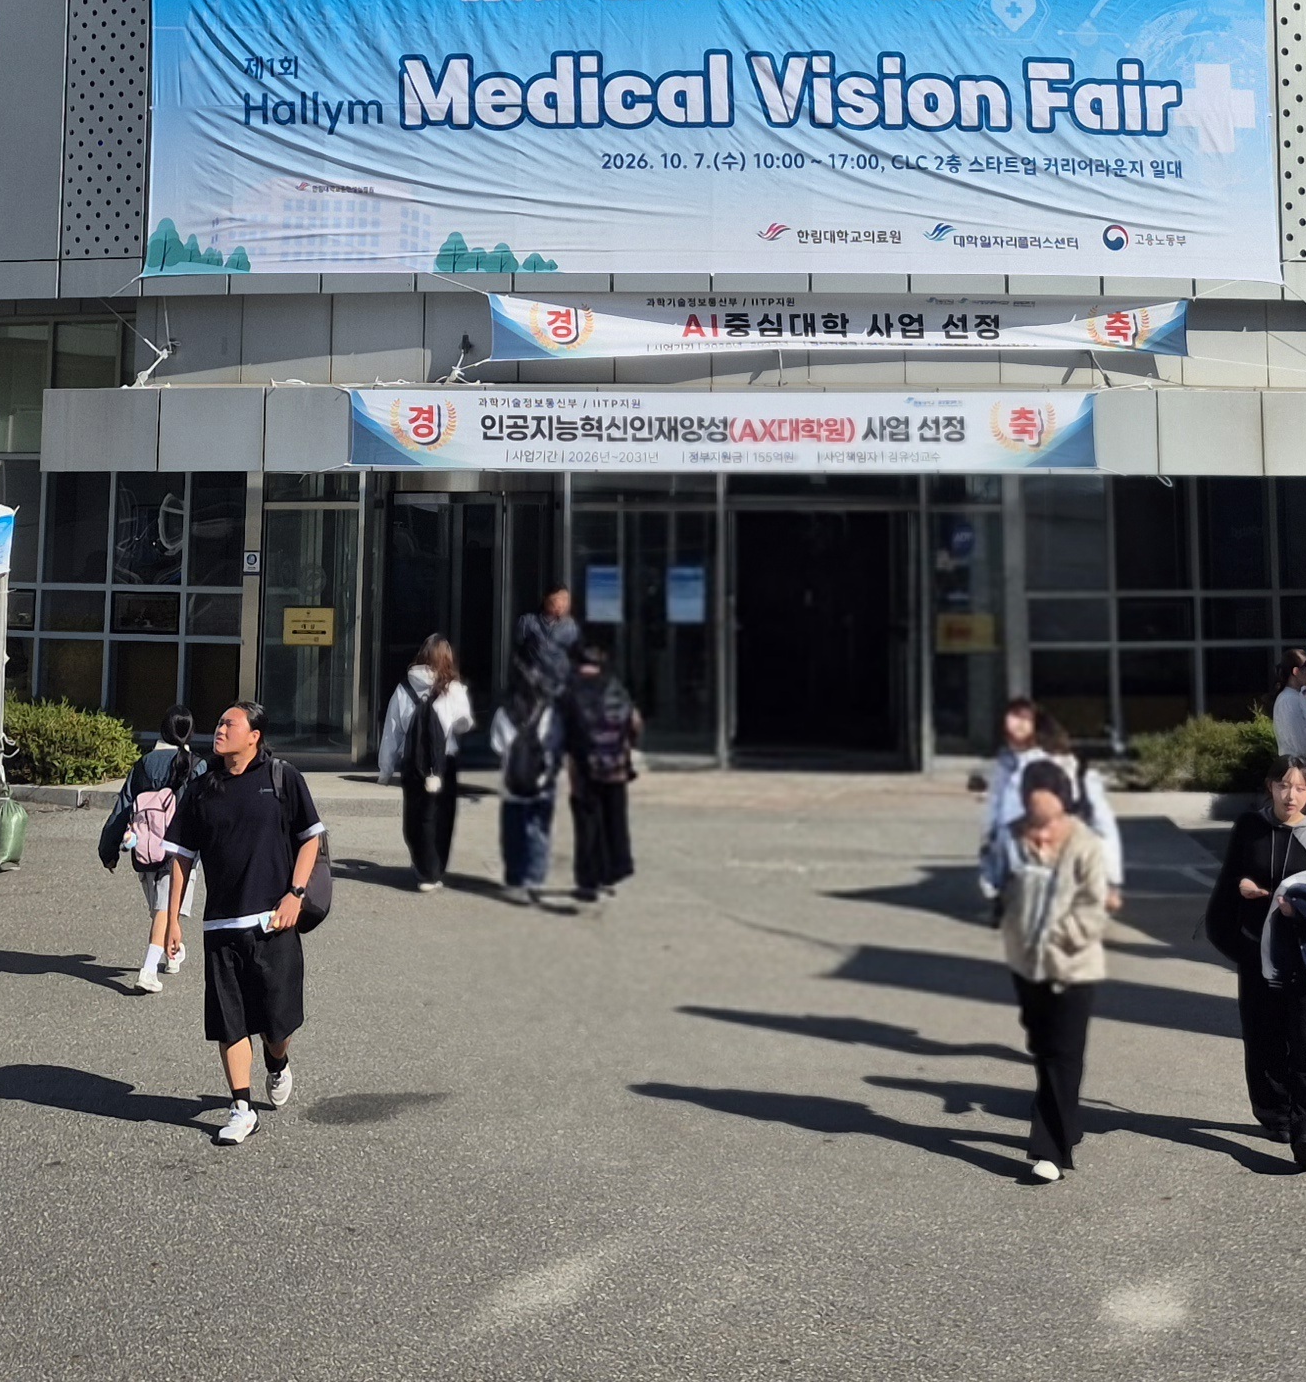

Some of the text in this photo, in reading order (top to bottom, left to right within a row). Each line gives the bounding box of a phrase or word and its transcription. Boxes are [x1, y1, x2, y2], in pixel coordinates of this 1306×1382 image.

[244, 55, 299, 79] 제1회
[243, 49, 1183, 137] Hallym Medical Vision Fair
[601, 153, 654, 170] 2026.
[661, 153, 688, 170] 10.
[754, 153, 805, 170] 10:00
[892, 154, 929, 171] CLC
[934, 154, 962, 174] 2층
[968, 156, 1037, 176] 스타트업
[1044, 157, 1144, 178] 커리어라운지
[1150, 159, 1183, 179] 일대
[796, 226, 902, 245] 한림대학교의료원
[953, 234, 1079, 250] 대학일자리플러스센터
[1135, 233, 1187, 247] 고용노동부
[646, 297, 738, 308] 과학기술정보통신부
[682, 313, 1001, 340] AI중심대학 사업 선정
[1105, 311, 1130, 342] 축
[479, 397, 577, 409] 과학기술정보통신부
[407, 405, 435, 439] 경
[862, 416, 910, 443] 사업
[917, 416, 966, 443] 선정
[1009, 407, 1037, 441] 축
[512, 450, 558, 463] 사업기간
